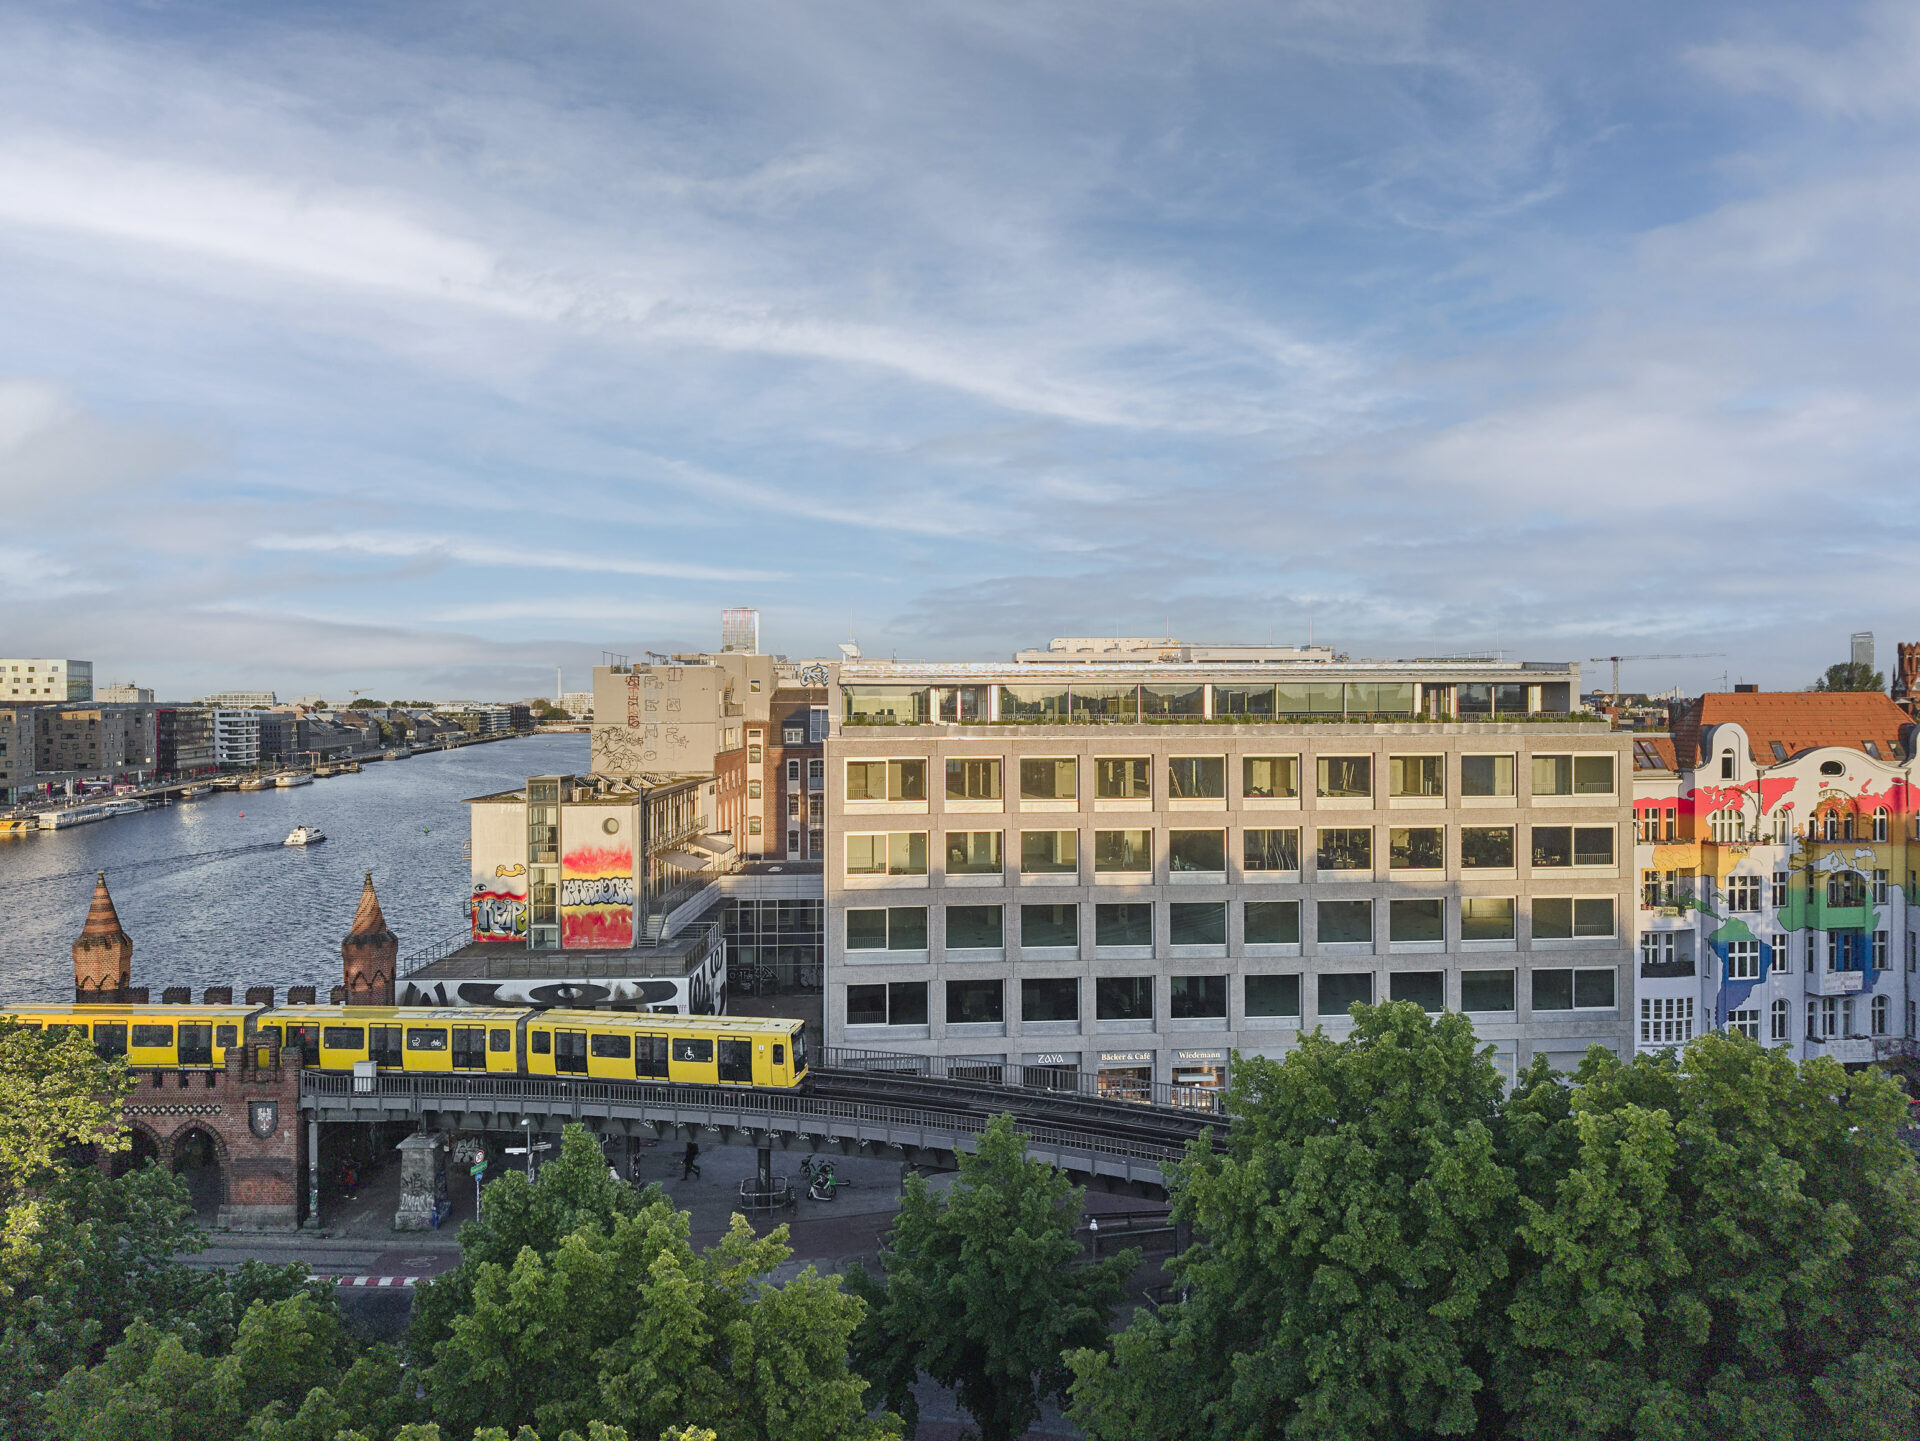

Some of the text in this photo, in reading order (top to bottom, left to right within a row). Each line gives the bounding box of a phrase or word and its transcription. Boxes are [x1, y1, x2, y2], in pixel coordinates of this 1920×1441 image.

[1037, 1054, 1064, 1064] ZAYA
[1134, 1052, 1151, 1060] Café
[1178, 1051, 1221, 1059] Wiedemann
